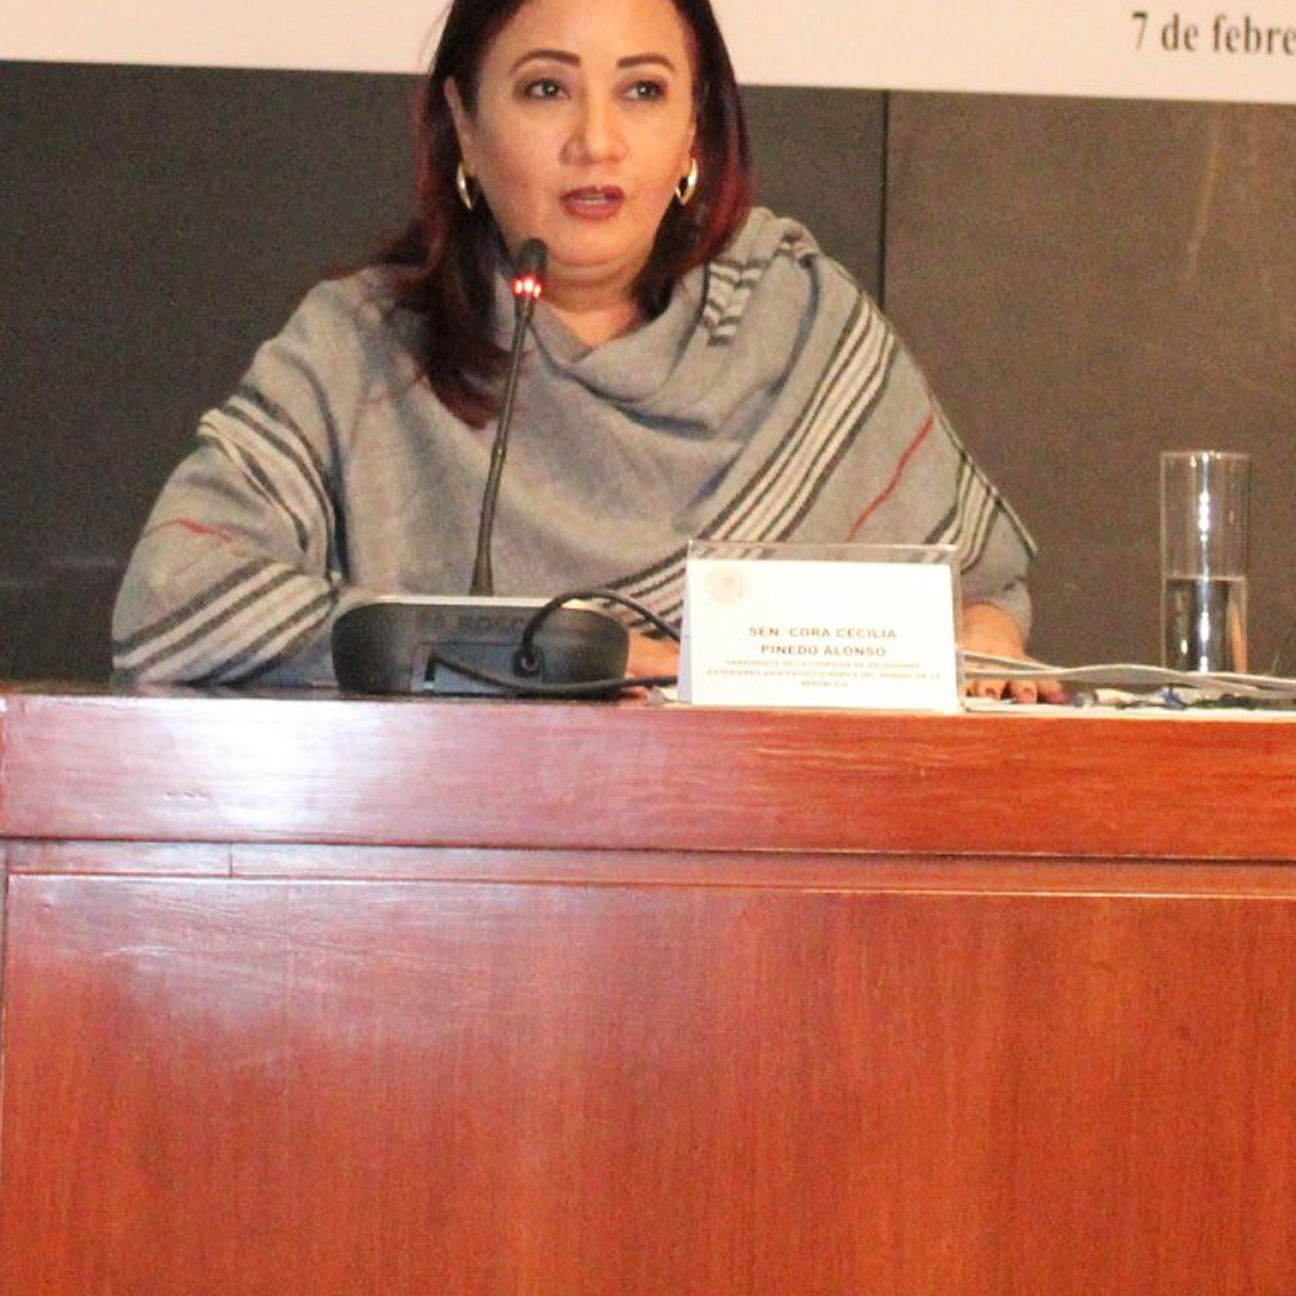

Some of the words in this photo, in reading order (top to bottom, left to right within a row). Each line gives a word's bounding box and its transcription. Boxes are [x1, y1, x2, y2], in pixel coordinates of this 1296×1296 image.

[1131, 10, 1150, 51] 7
[1160, 12, 1199, 52] de
[789, 627, 831, 638] CORA
[836, 627, 897, 639] CECILIA
[760, 643, 819, 656] PINEDO
[823, 645, 887, 657] ALONSO
